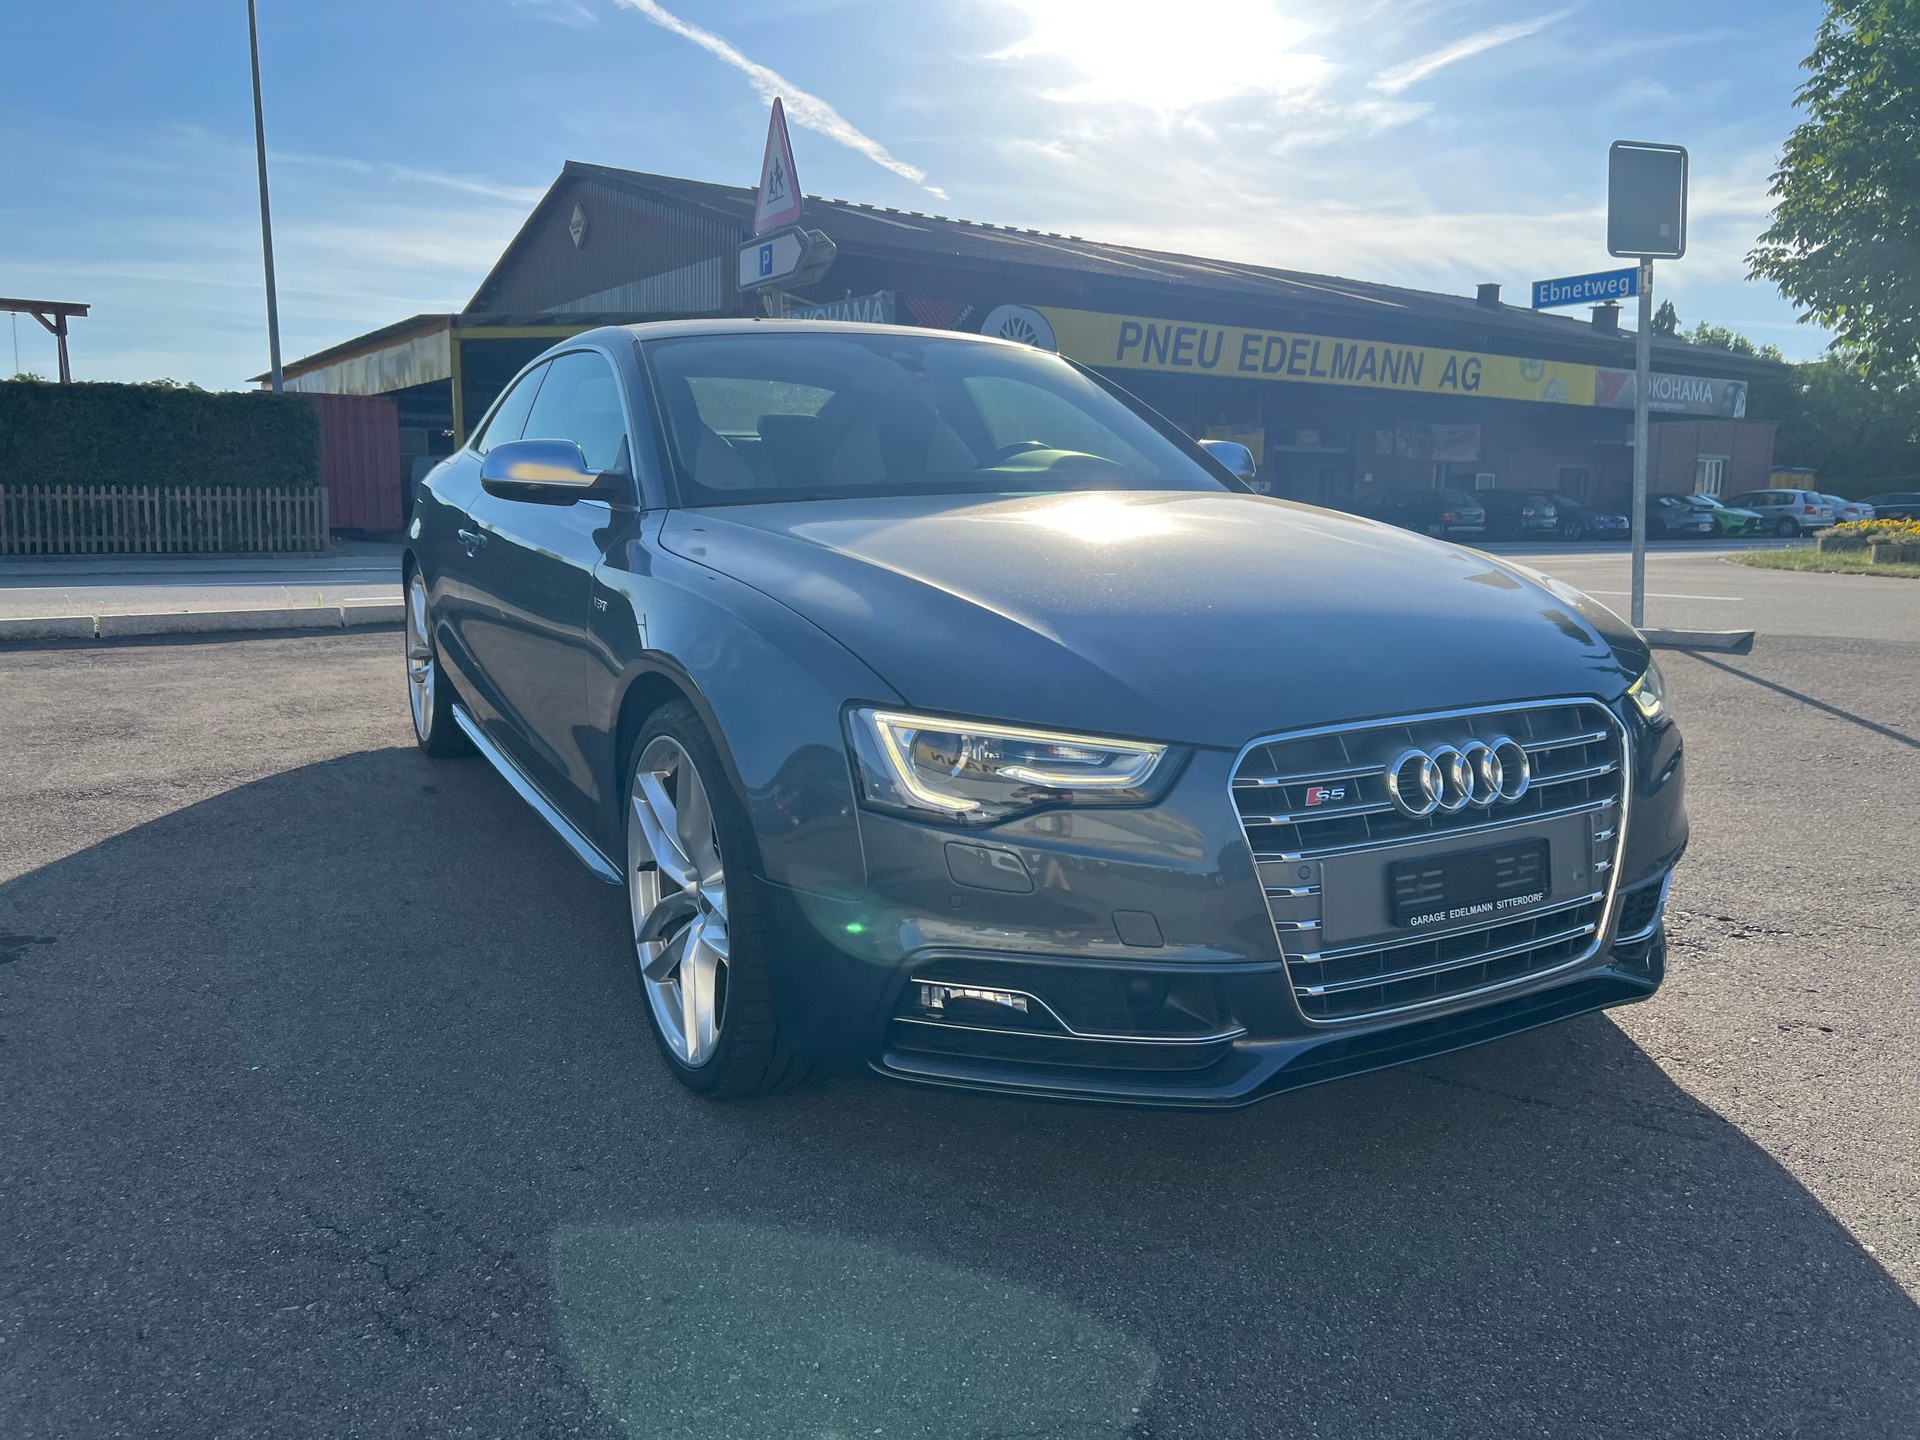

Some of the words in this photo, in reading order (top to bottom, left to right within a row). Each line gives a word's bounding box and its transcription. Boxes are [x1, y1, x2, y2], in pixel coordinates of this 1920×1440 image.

[762, 250, 770, 273] P
[1539, 277, 1630, 303] Ebnetweg
[788, 299, 885, 324] OHAMA
[1115, 321, 1224, 369] PNEU
[1237, 333, 1425, 386] EDELMANN
[1438, 355, 1482, 391] AG
[1632, 374, 1713, 403] KOHAMA
[1315, 788, 1345, 801] S5
[1410, 911, 1446, 926] GARAGE
[1449, 902, 1493, 919] EDELMANN
[1496, 892, 1544, 910] SITTERDORF
